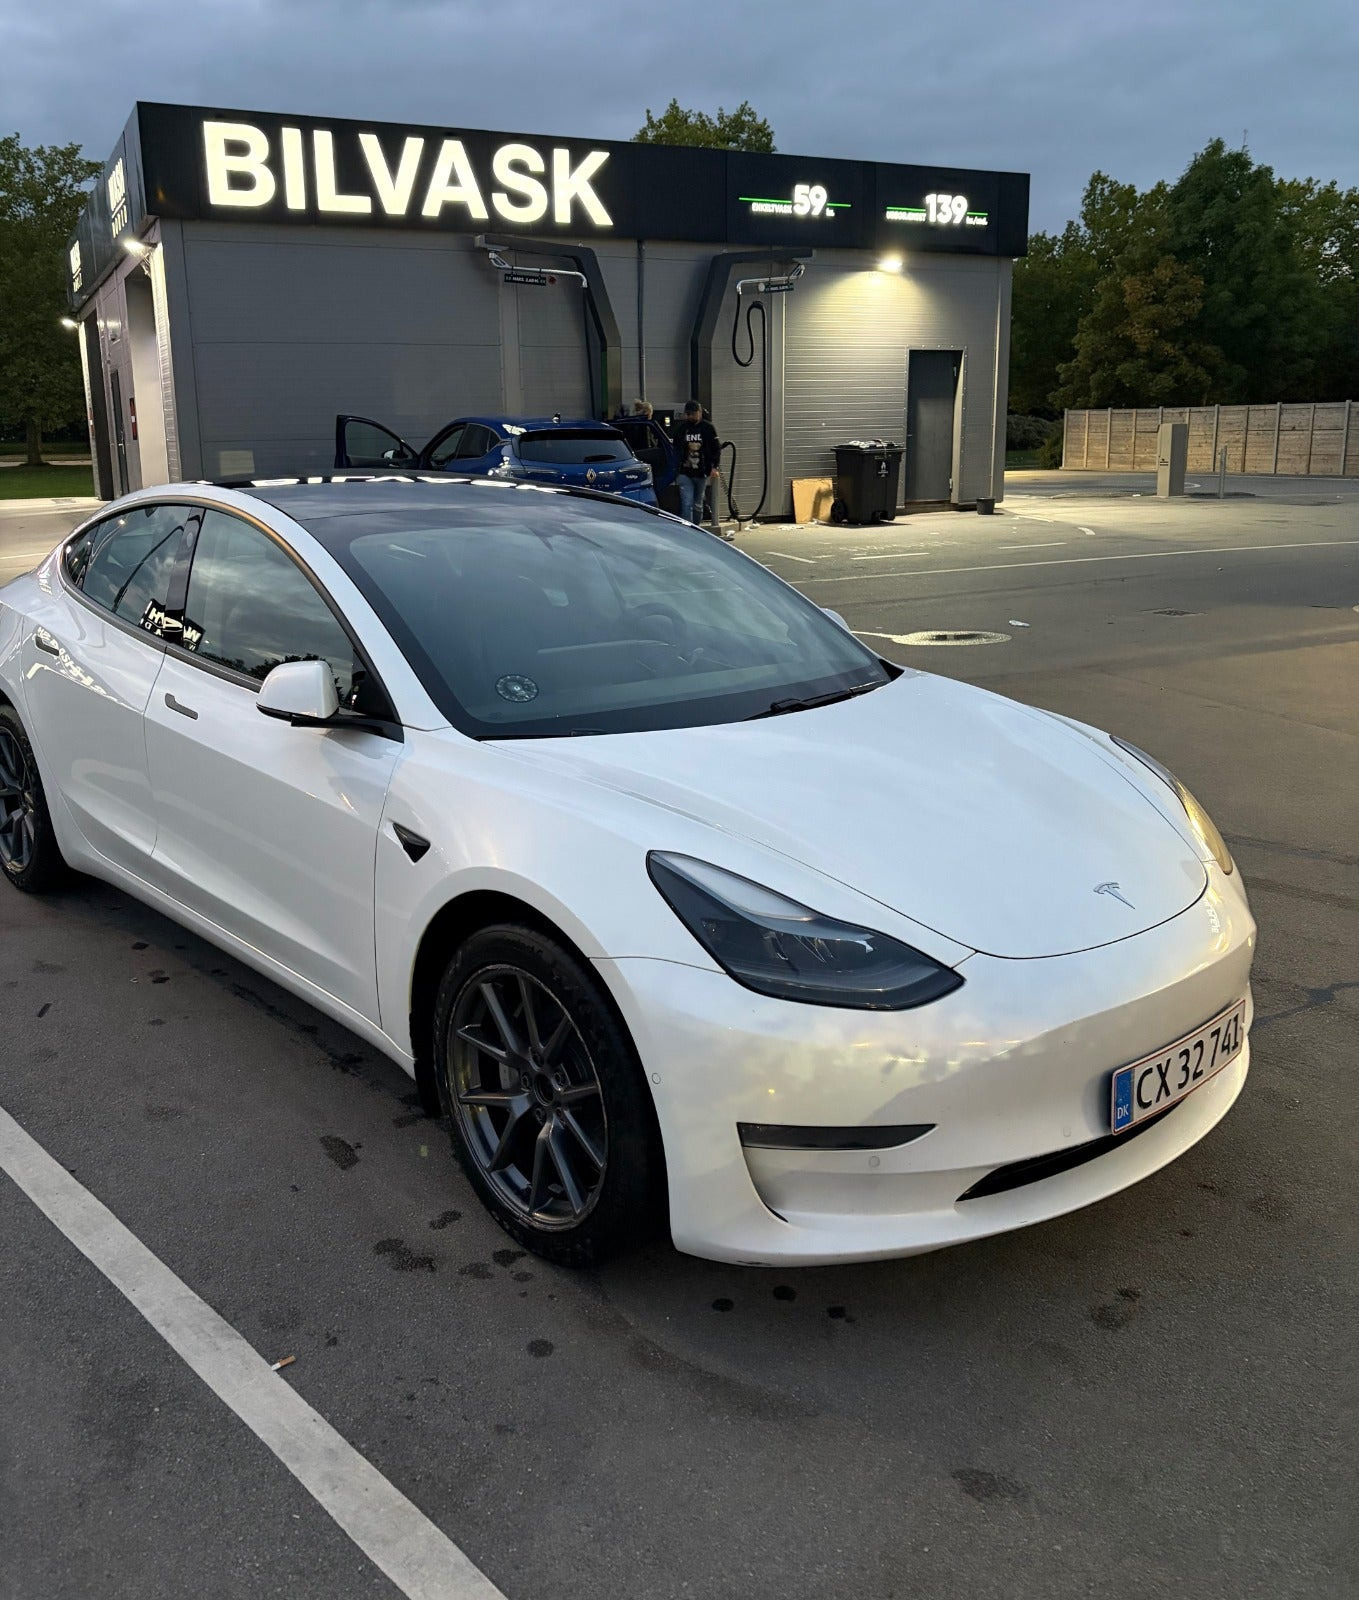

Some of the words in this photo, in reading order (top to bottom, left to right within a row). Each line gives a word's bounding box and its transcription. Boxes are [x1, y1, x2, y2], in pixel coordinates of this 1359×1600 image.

[203, 121, 613, 226] BILVASK
[793, 184, 827, 216] 59
[925, 193, 968, 224] 139
[1136, 1058, 1172, 1110] CX
[1177, 1040, 1204, 1090] 32
[1210, 1013, 1240, 1068] 741
[1117, 1103, 1129, 1120] DK
